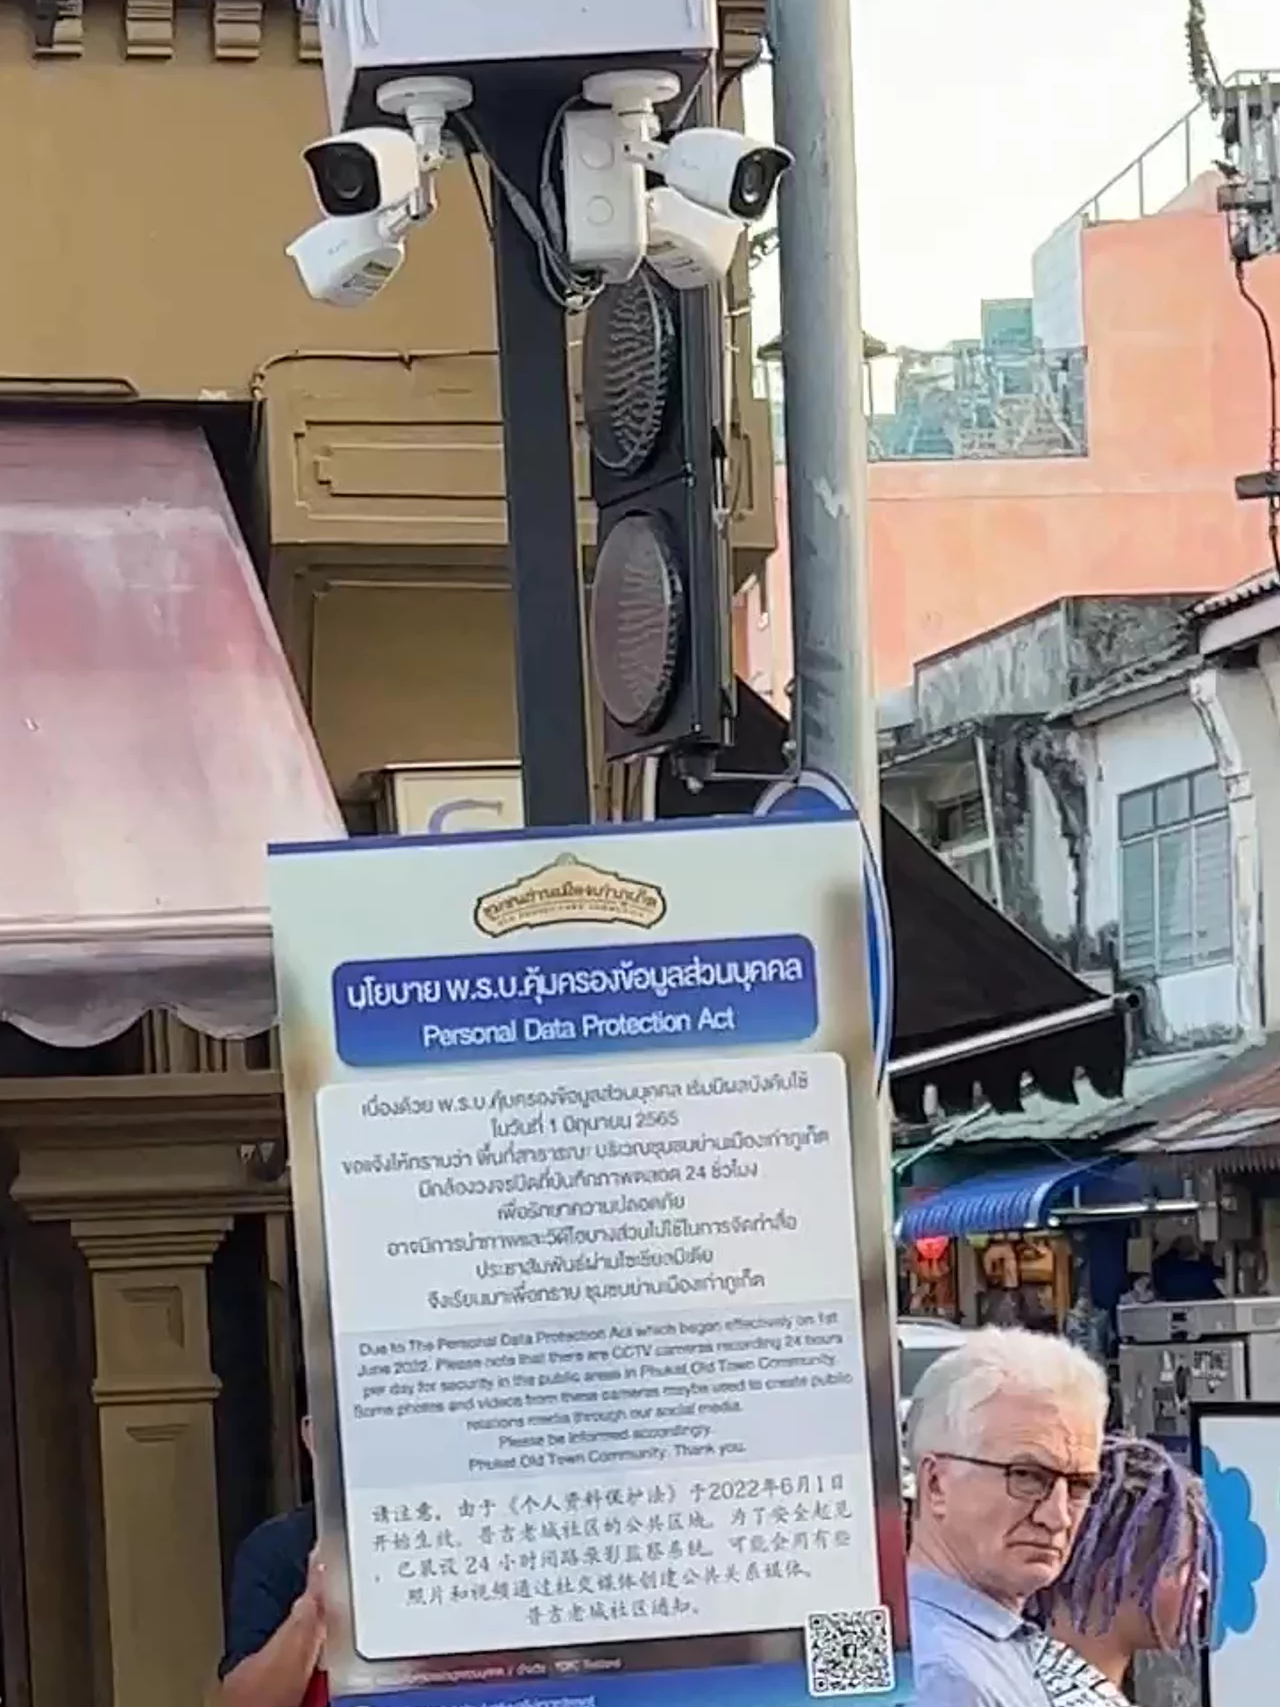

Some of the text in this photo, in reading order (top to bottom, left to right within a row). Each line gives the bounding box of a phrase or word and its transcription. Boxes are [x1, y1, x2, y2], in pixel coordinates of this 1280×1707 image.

[347, 954, 803, 1010] นโยบาย พ.ร.บ.คุ้มครองข้อมูลส่วนบุคคล
[423, 1004, 734, 1049] Personal Data Protection Act
[550, 1118, 555, 1132] 1
[634, 1110, 679, 1127] 2565
[685, 1165, 706, 1180] 24
[611, 1344, 651, 1358] CCTV
[784, 1335, 800, 1347] 24
